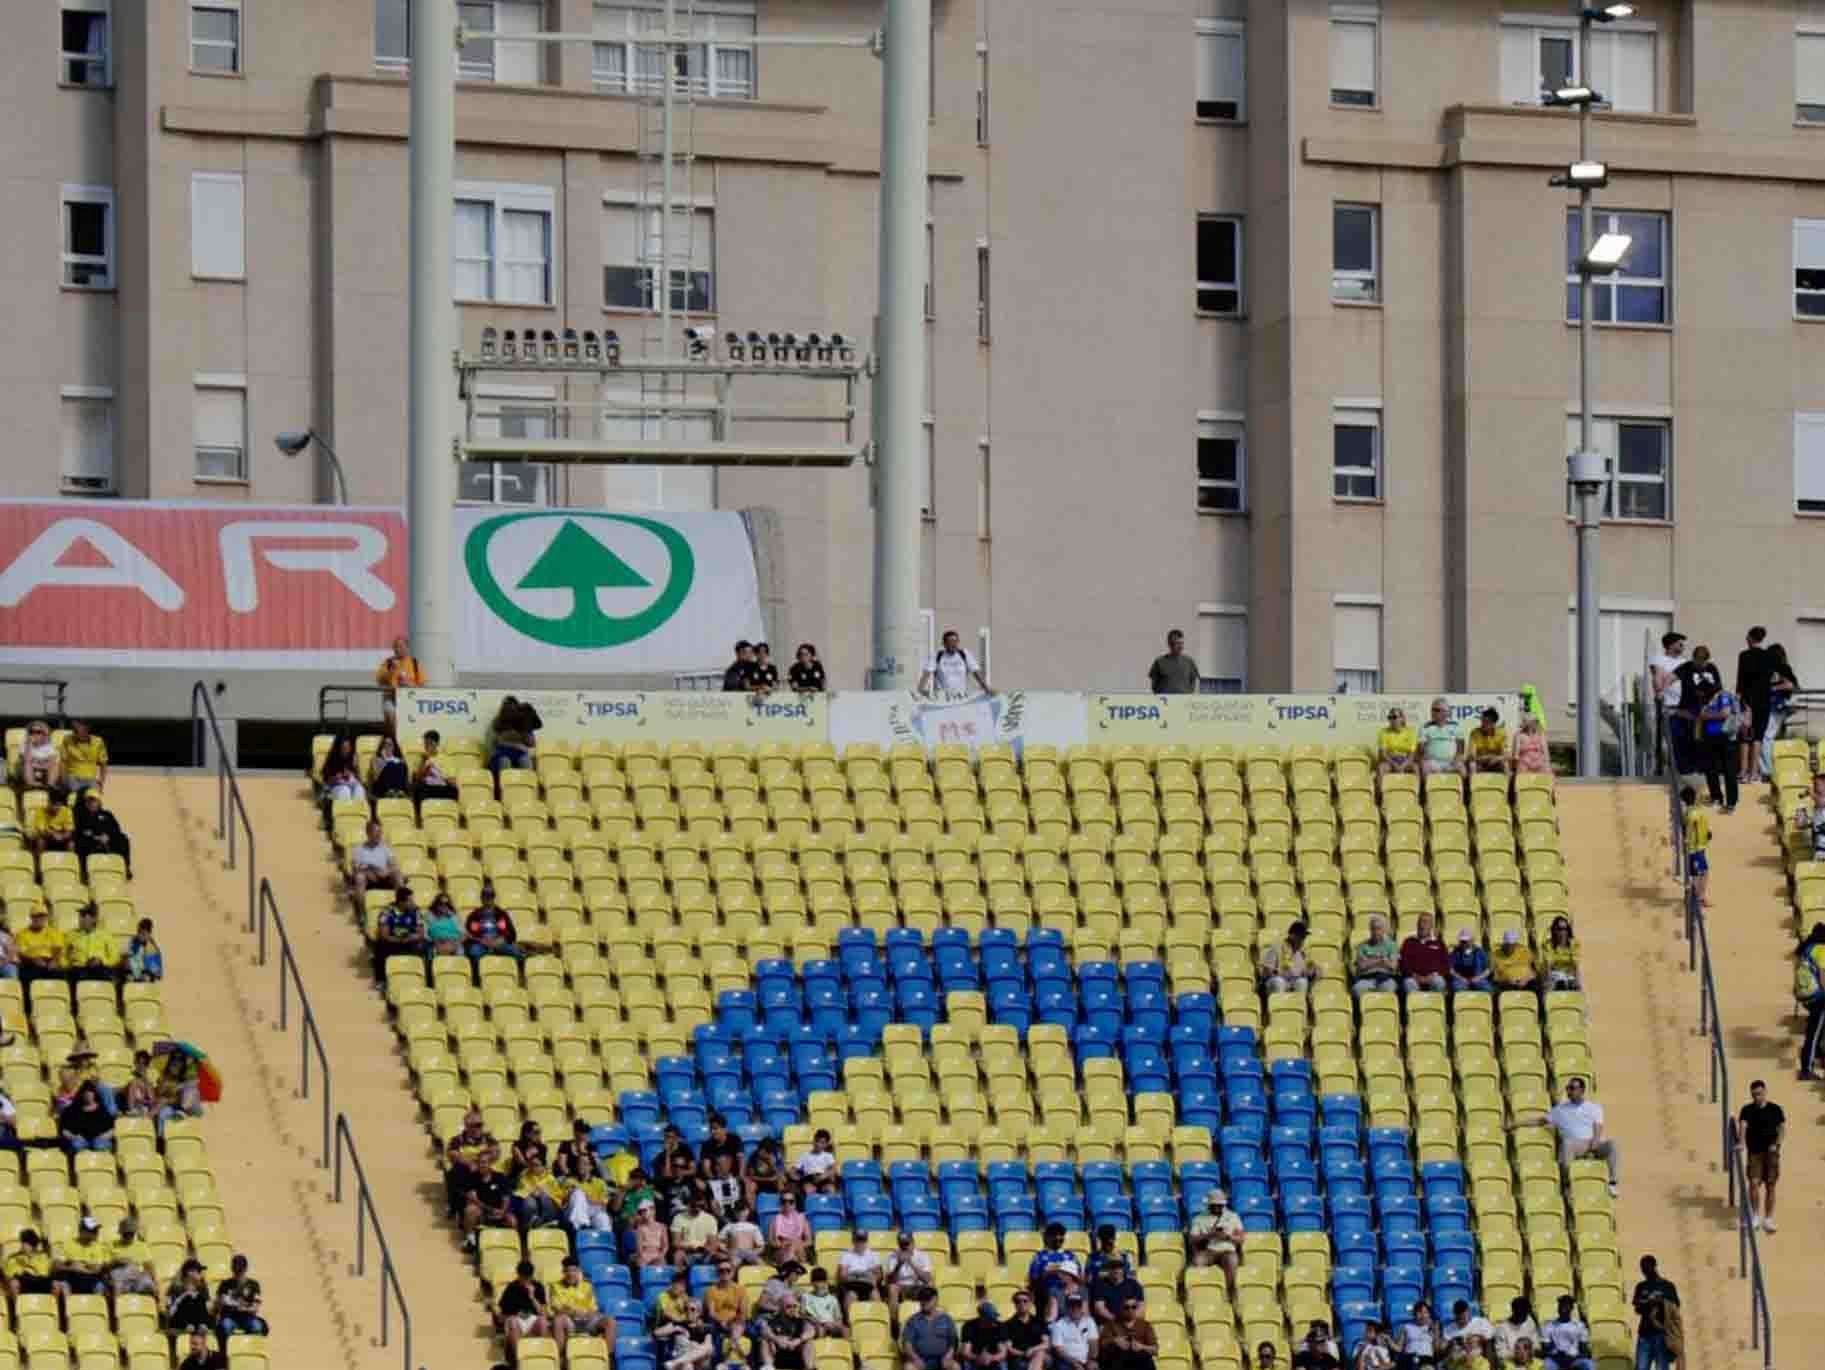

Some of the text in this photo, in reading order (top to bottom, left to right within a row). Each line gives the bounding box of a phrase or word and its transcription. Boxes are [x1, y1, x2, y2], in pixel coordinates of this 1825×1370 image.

[0, 517, 398, 613] AR
[415, 700, 470, 715] TIPSA
[584, 701, 638, 717] TIPSA
[753, 702, 808, 718] TIPSA
[1106, 705, 1160, 720] TIPSA
[1275, 705, 1328, 720] TIPSA
